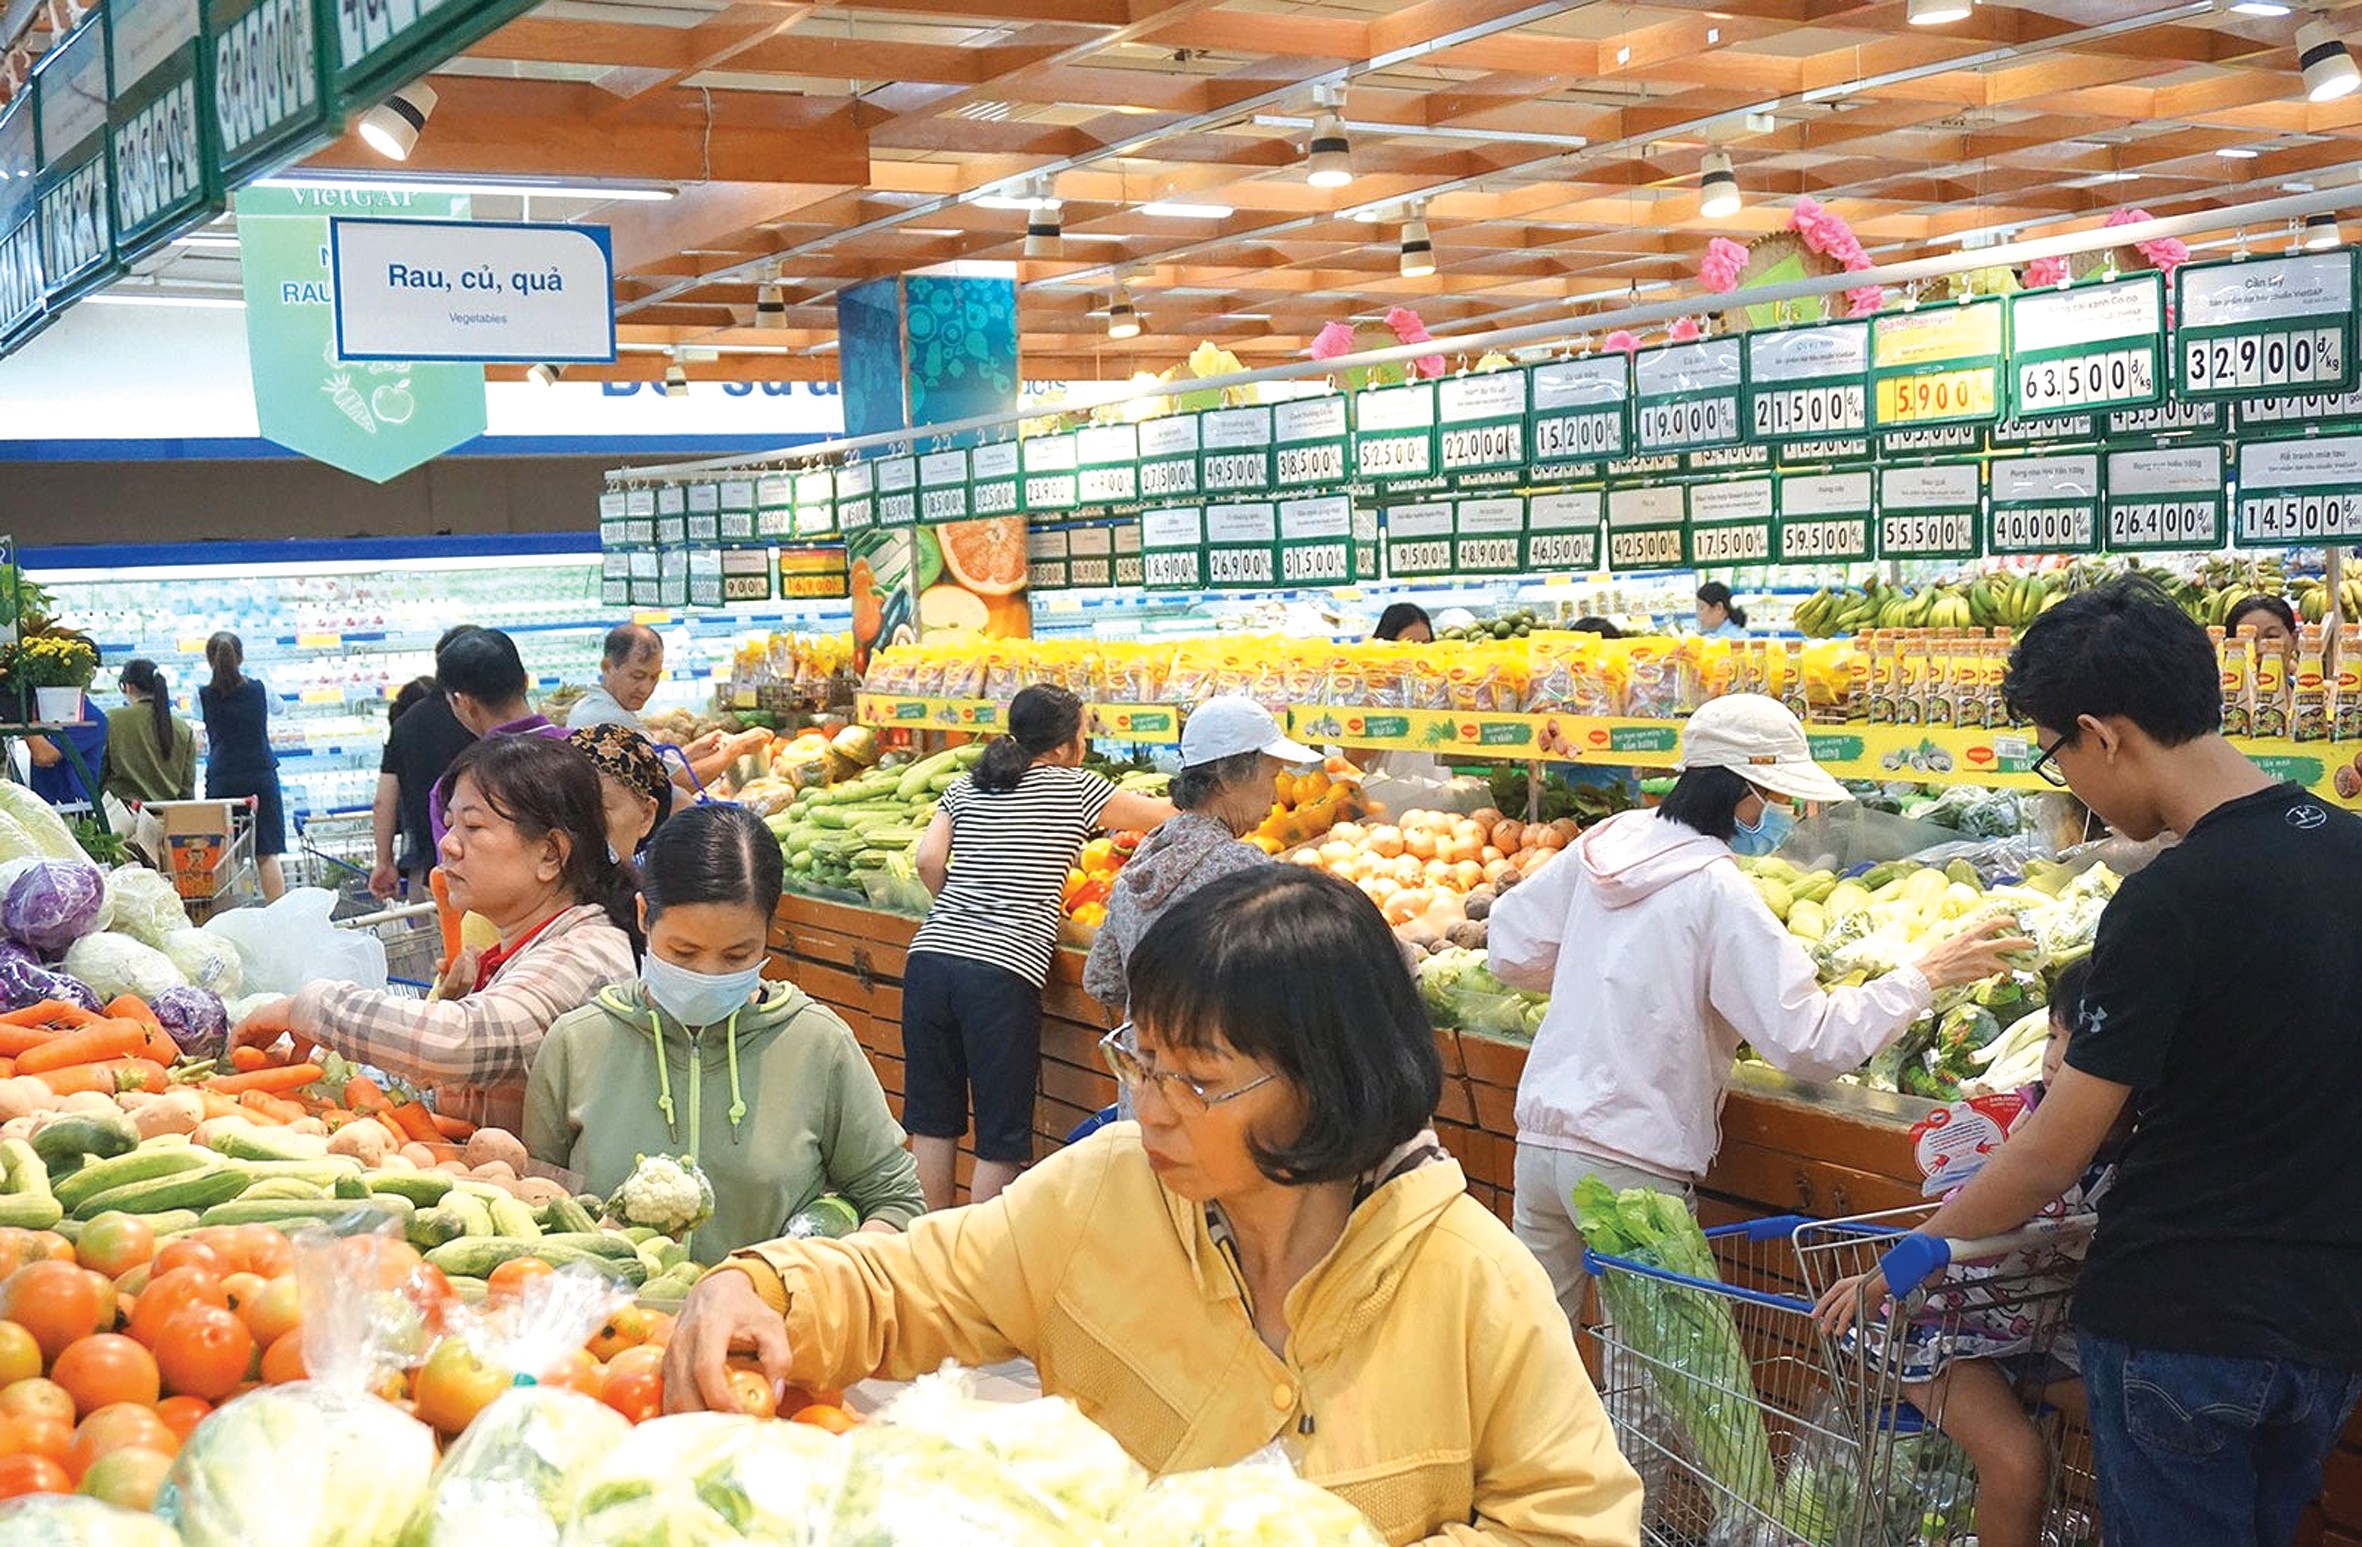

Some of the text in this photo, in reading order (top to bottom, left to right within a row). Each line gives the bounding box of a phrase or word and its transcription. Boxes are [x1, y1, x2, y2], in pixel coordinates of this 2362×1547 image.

[389, 263, 562, 296] Rau, củ, quả
[450, 312, 507, 325] Vegetables
[2190, 339, 2311, 380] 32.900
[2026, 360, 2125, 399] 63.500
[1897, 380, 1968, 413] 5.900
[1645, 405, 1717, 437] 19.000
[1757, 393, 1842, 427] 21.500
[1445, 433, 1504, 459] 22.000
[1539, 420, 1604, 450] 15.200
[1279, 451, 1330, 477] 38.500
[1996, 514, 2072, 540] 40.000
[2114, 508, 2195, 535] 26.400
[2248, 501, 2339, 531] 14.500
[1696, 532, 1754, 556] 17.500
[1785, 527, 1848, 551] 59.500
[1886, 522, 1954, 544] 55.500
[1400, 546, 1438, 565] 9.500
[1460, 543, 1507, 563] 48.900
[1532, 540, 1582, 561] 46.500
[1614, 536, 1668, 558] 42.500
[1211, 554, 1260, 576] 26.900
[1285, 550, 1334, 575] 31.500
